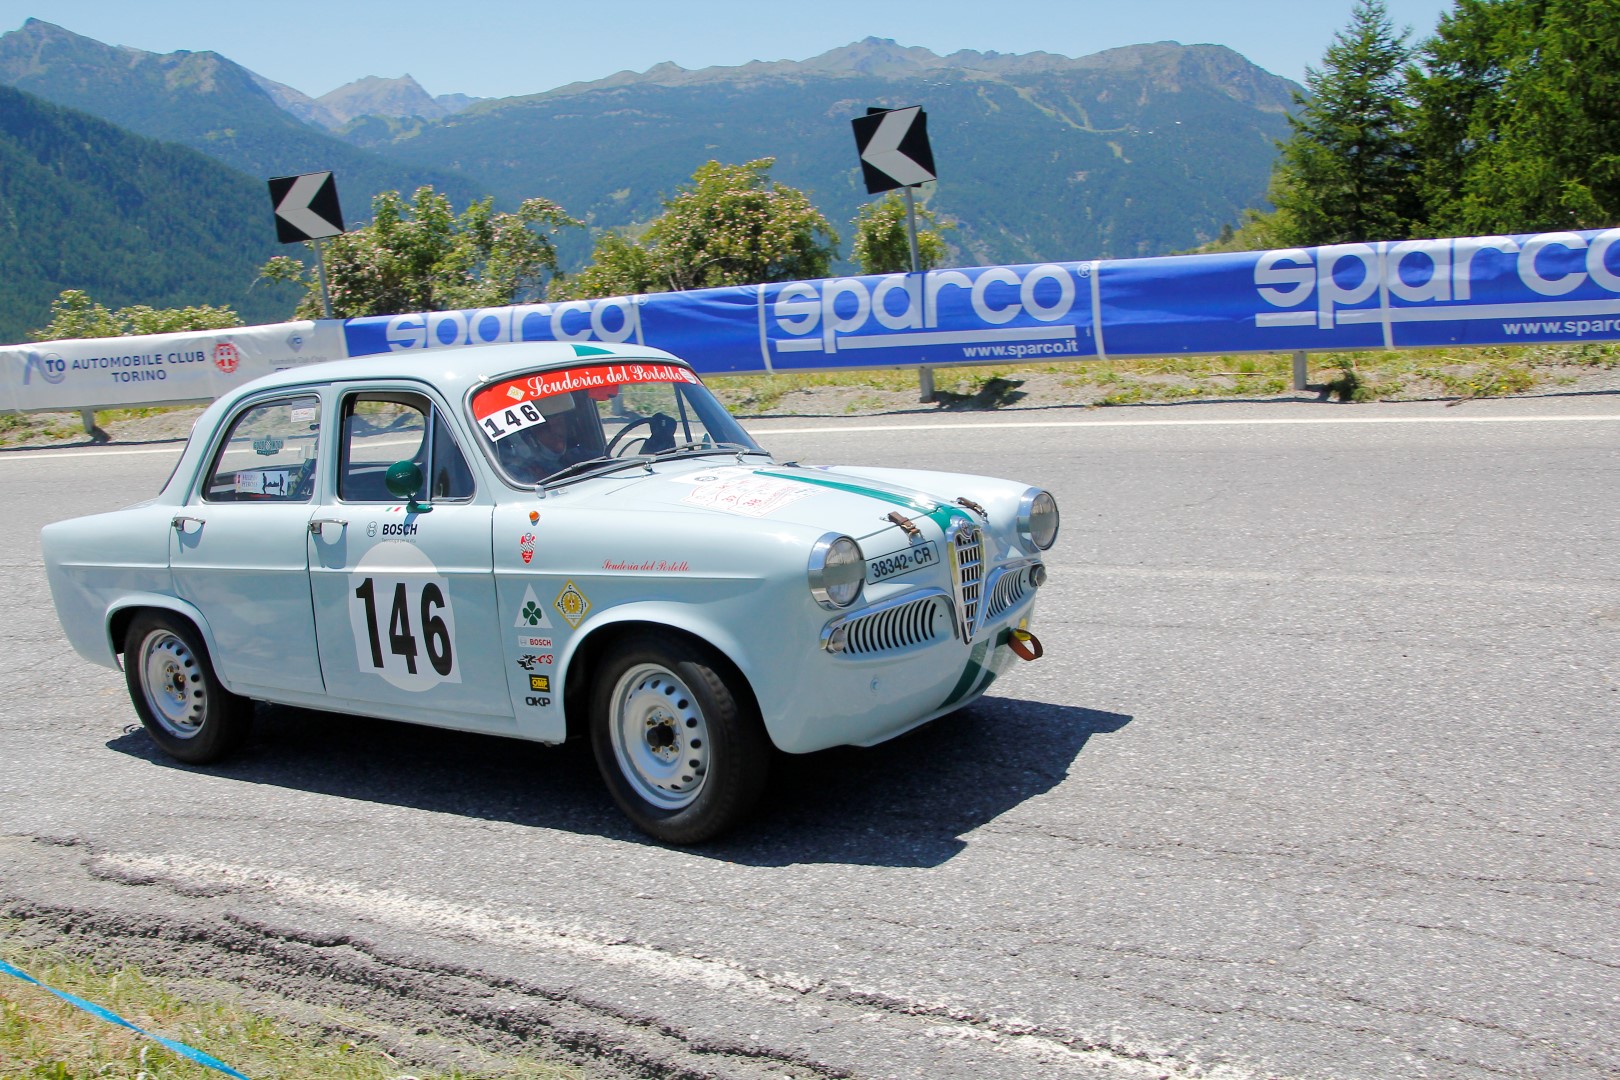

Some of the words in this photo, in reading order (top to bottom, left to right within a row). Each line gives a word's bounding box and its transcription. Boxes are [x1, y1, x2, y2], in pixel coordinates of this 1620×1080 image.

[963, 339, 1079, 359] www.sparco.it
[72, 353, 164, 371] AUTOMOBILE
[167, 351, 206, 365] CLUB
[112, 369, 167, 383] TORINO
[527, 371, 604, 397] Scuderia
[608, 366, 630, 382] del
[629, 363, 683, 382] Portello
[484, 404, 541, 438] 146
[382, 523, 418, 536] BOSCH
[640, 560, 656, 571] del
[871, 554, 909, 578] 38342
[913, 542, 932, 565] CR
[355, 577, 453, 677] 146
[529, 638, 552, 647] BOSCH
[531, 679, 548, 688] OMP
[525, 696, 551, 707] OKP
